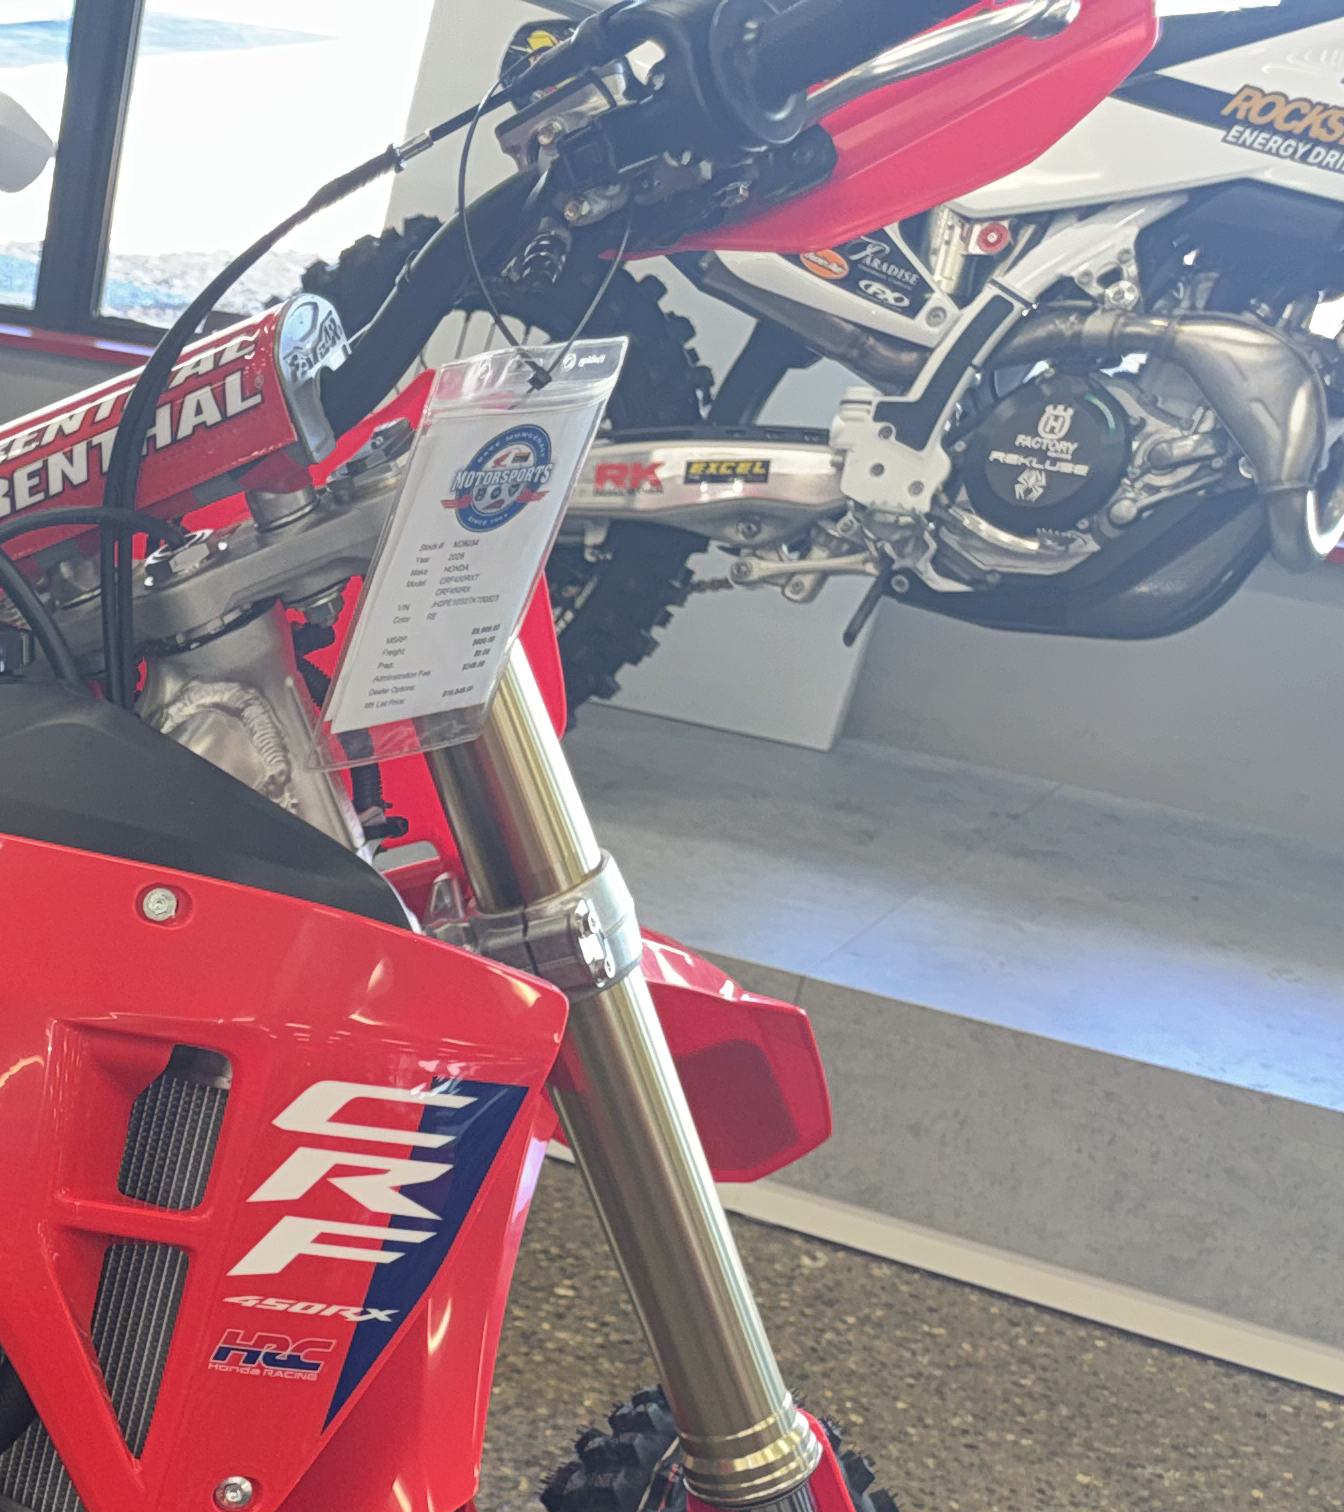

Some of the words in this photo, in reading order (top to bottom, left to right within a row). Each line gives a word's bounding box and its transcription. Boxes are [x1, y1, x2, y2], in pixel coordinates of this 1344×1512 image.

[1220, 86, 1344, 144] ROCKS
[1225, 124, 1313, 161] ENERGY
[1015, 434, 1080, 456] FACTORY
[451, 463, 554, 493] MOTORSPORTS
[594, 461, 666, 489] RK
[688, 460, 768, 475] EXCEL
[225, 1079, 479, 1277] CRF
[223, 1295, 400, 1322] 450RX
[209, 1328, 337, 1374] HRC
[208, 1362, 261, 1376] Honda
[262, 1369, 318, 1382] RACING
